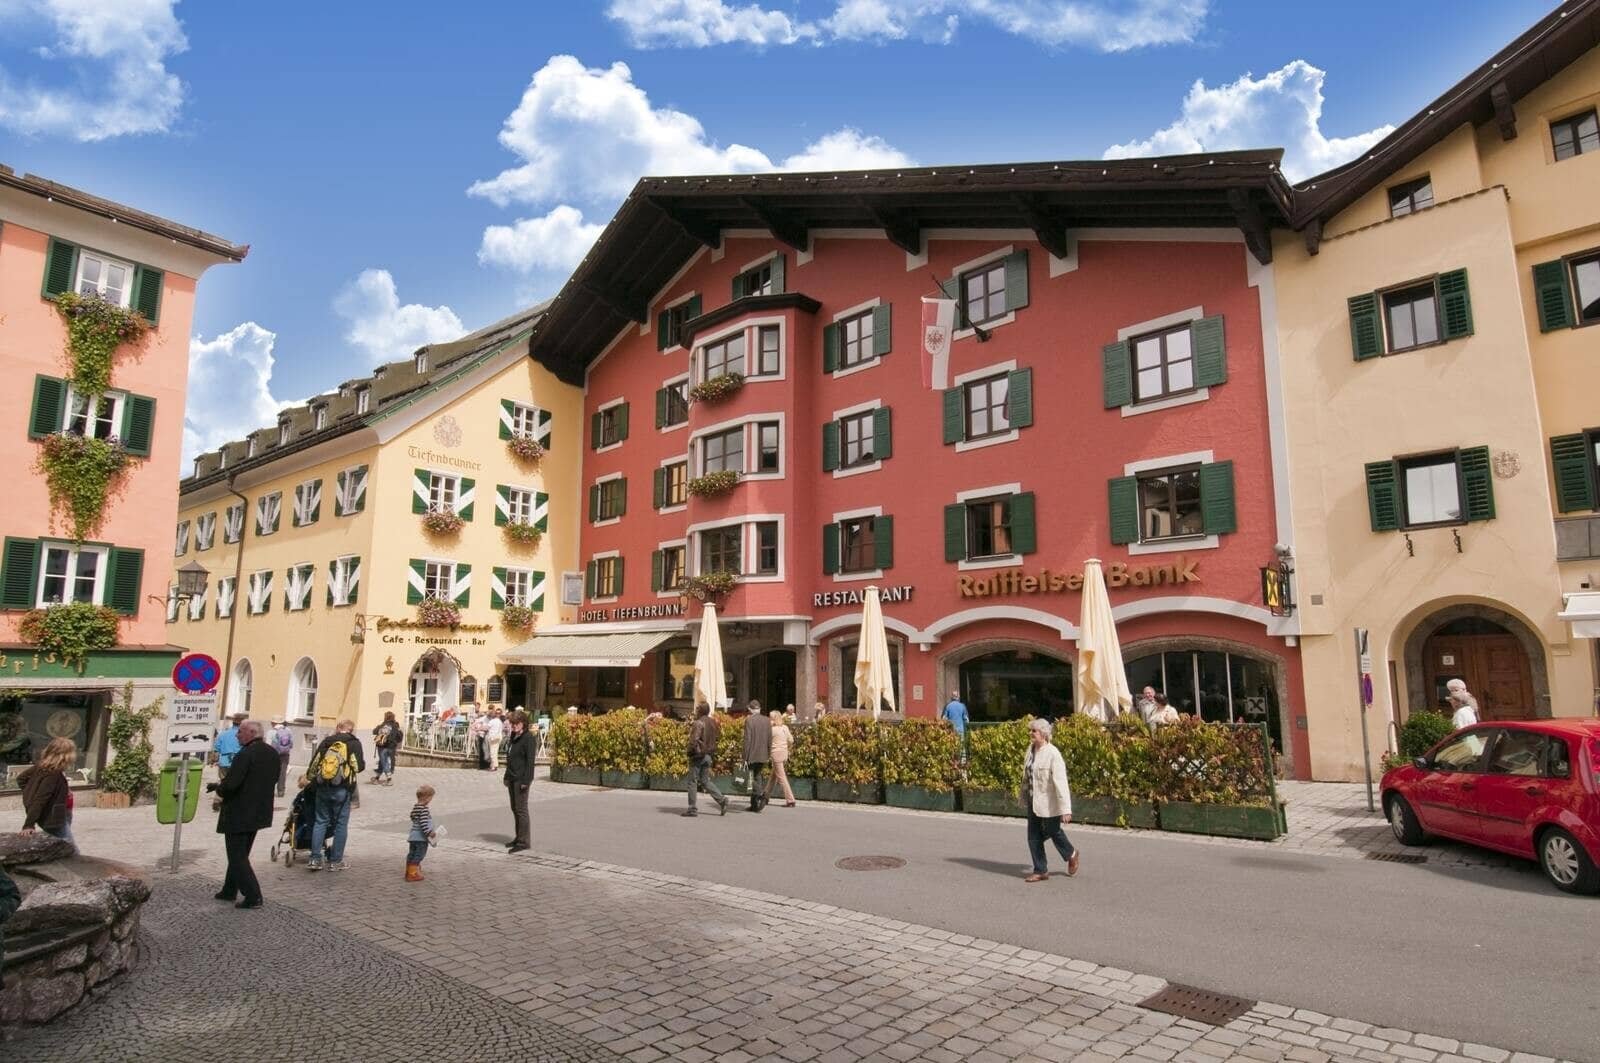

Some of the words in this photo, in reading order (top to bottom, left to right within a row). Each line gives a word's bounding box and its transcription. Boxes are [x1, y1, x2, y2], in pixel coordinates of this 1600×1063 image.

[408, 445, 482, 471] Tiefenbrunner
[957, 567, 1083, 597] Raiffeise
[1107, 554, 1201, 588] Bank
[814, 585, 913, 606] RESTAUANT
[581, 609, 607, 621] HOTEL
[382, 635, 404, 644] Cafe
[415, 636, 461, 645] Restaurant
[472, 638, 486, 646] Bar
[183, 705, 198, 713] TAXI
